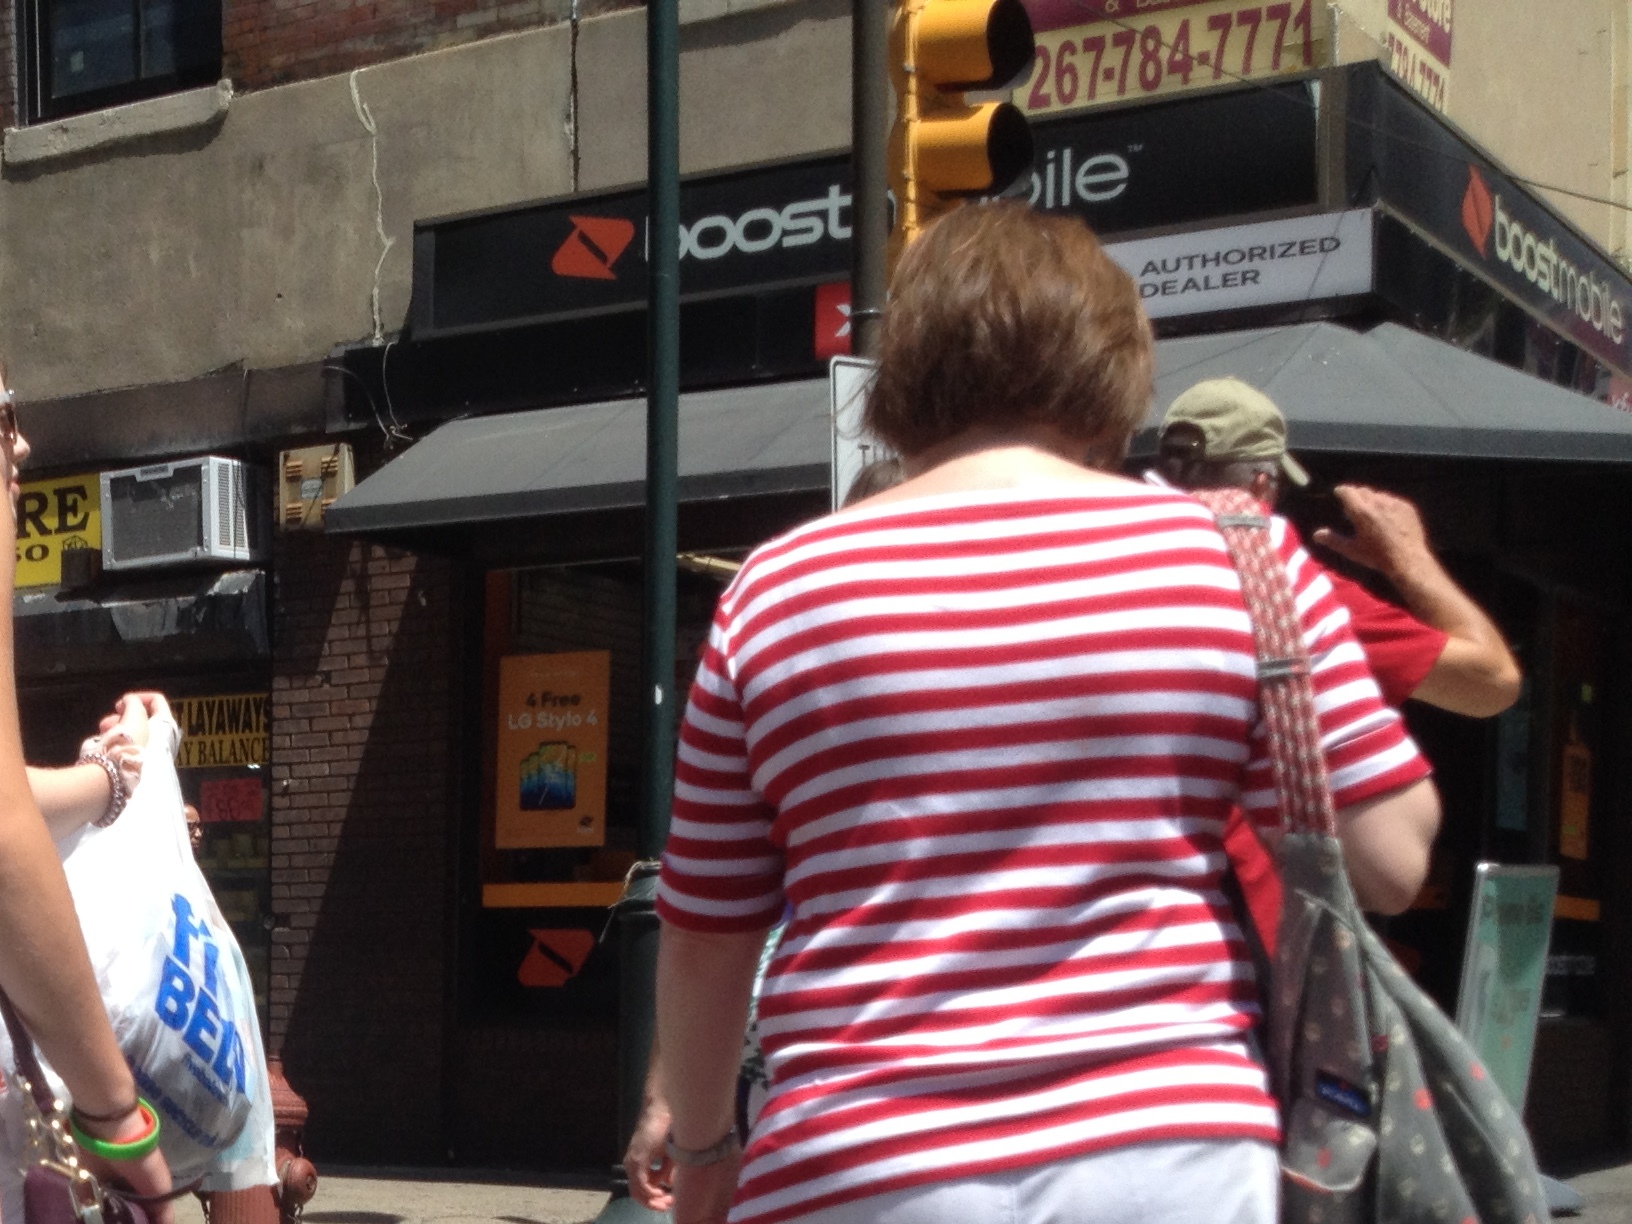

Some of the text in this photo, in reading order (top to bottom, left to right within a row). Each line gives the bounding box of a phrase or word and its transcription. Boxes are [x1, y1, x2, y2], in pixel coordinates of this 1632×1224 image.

[1028, 0, 1314, 110] 267-784-7771
[645, 184, 852, 262] oost
[1140, 236, 1342, 278] AUTHORIZED
[1139, 269, 1261, 300] DEALER
[541, 690, 582, 708] Free
[508, 713, 533, 730] LG
